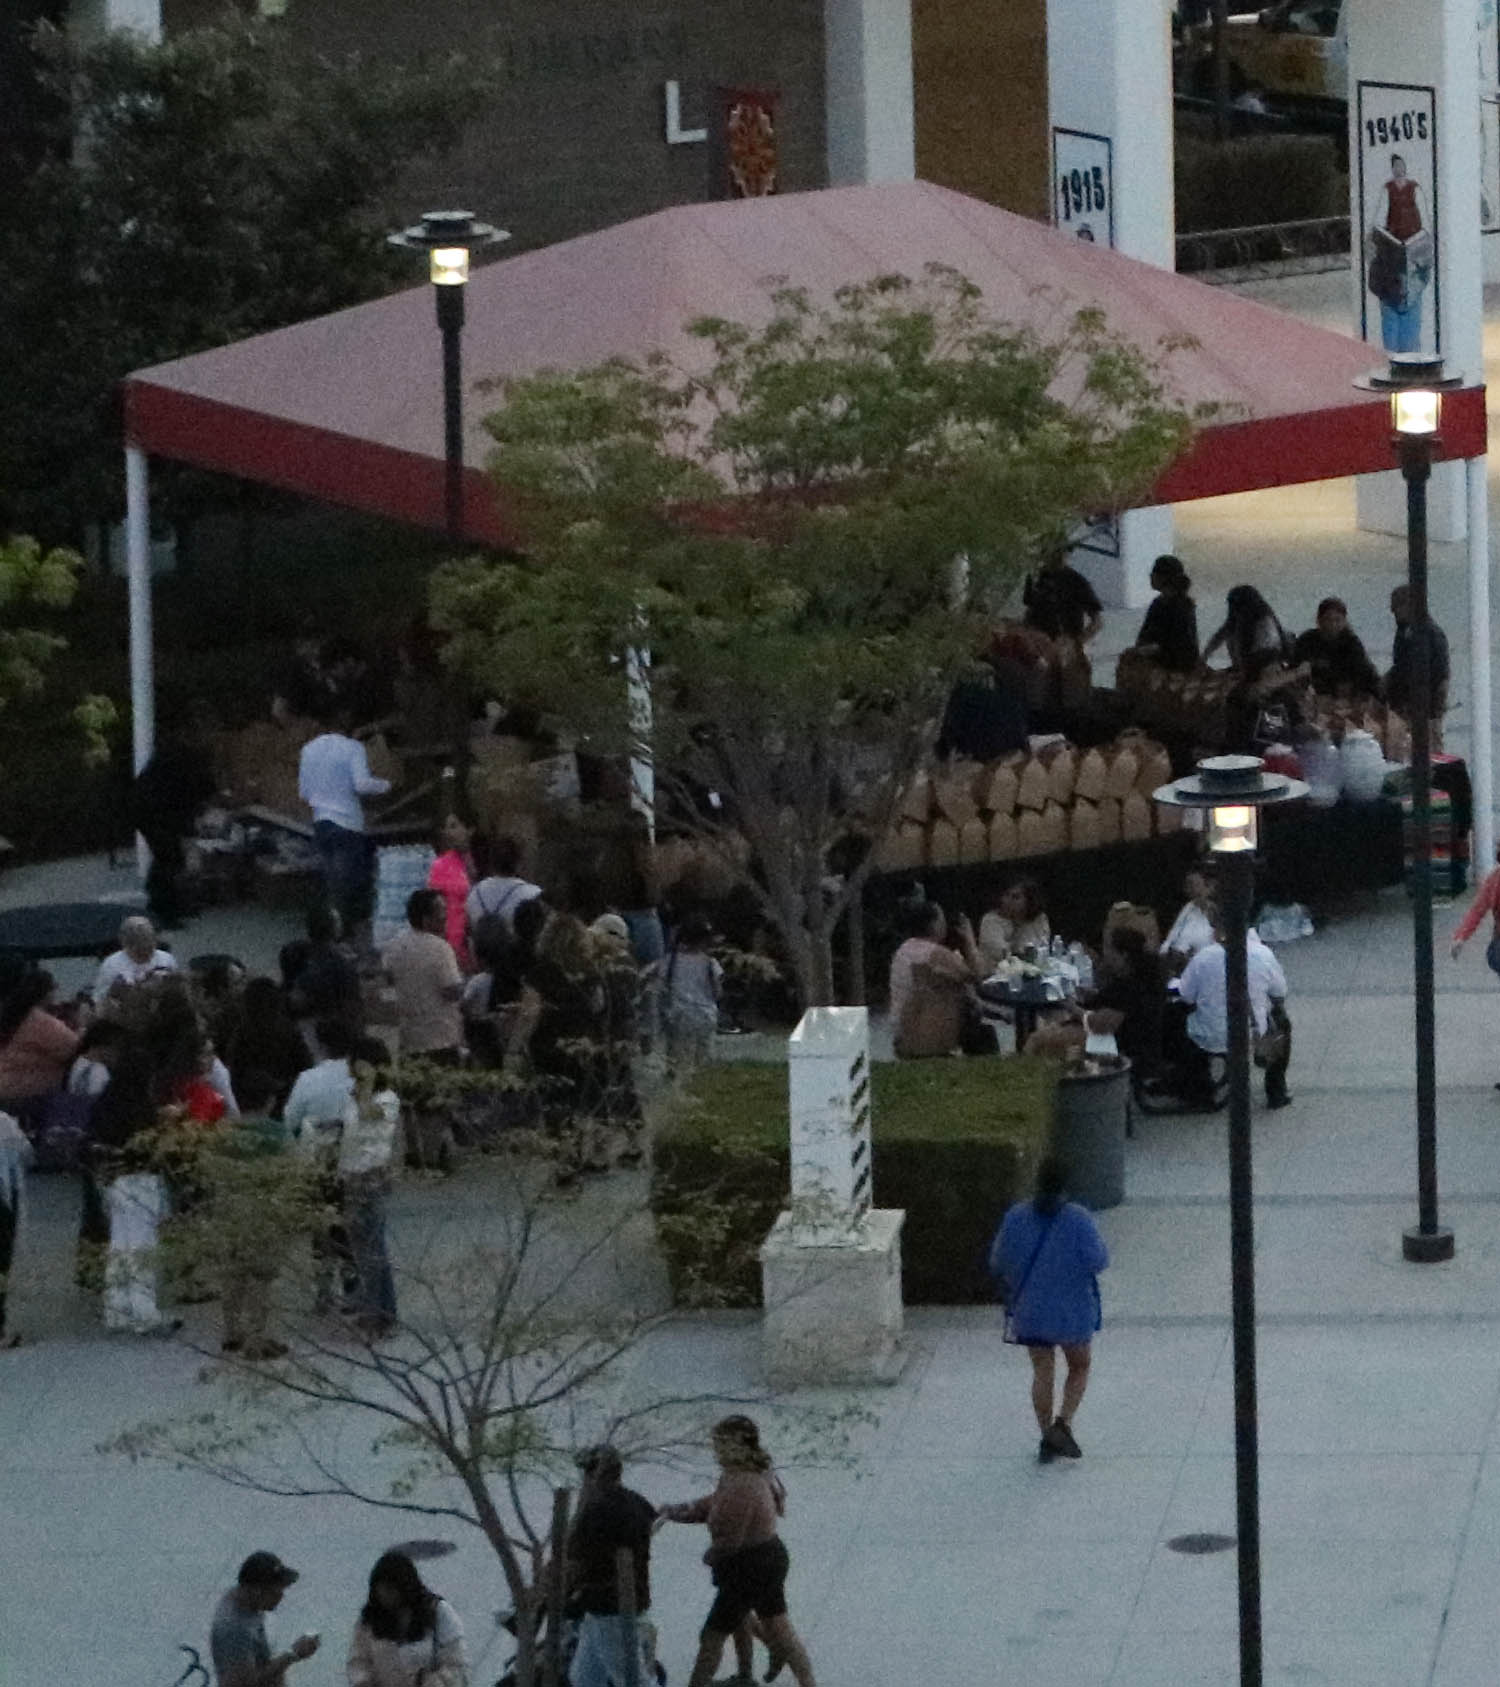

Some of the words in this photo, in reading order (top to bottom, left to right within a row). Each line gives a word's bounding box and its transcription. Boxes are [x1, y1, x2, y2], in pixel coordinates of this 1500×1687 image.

[665, 80, 709, 145] L
[1366, 110, 1428, 148] 1940'S
[1061, 166, 1107, 216] 1915
